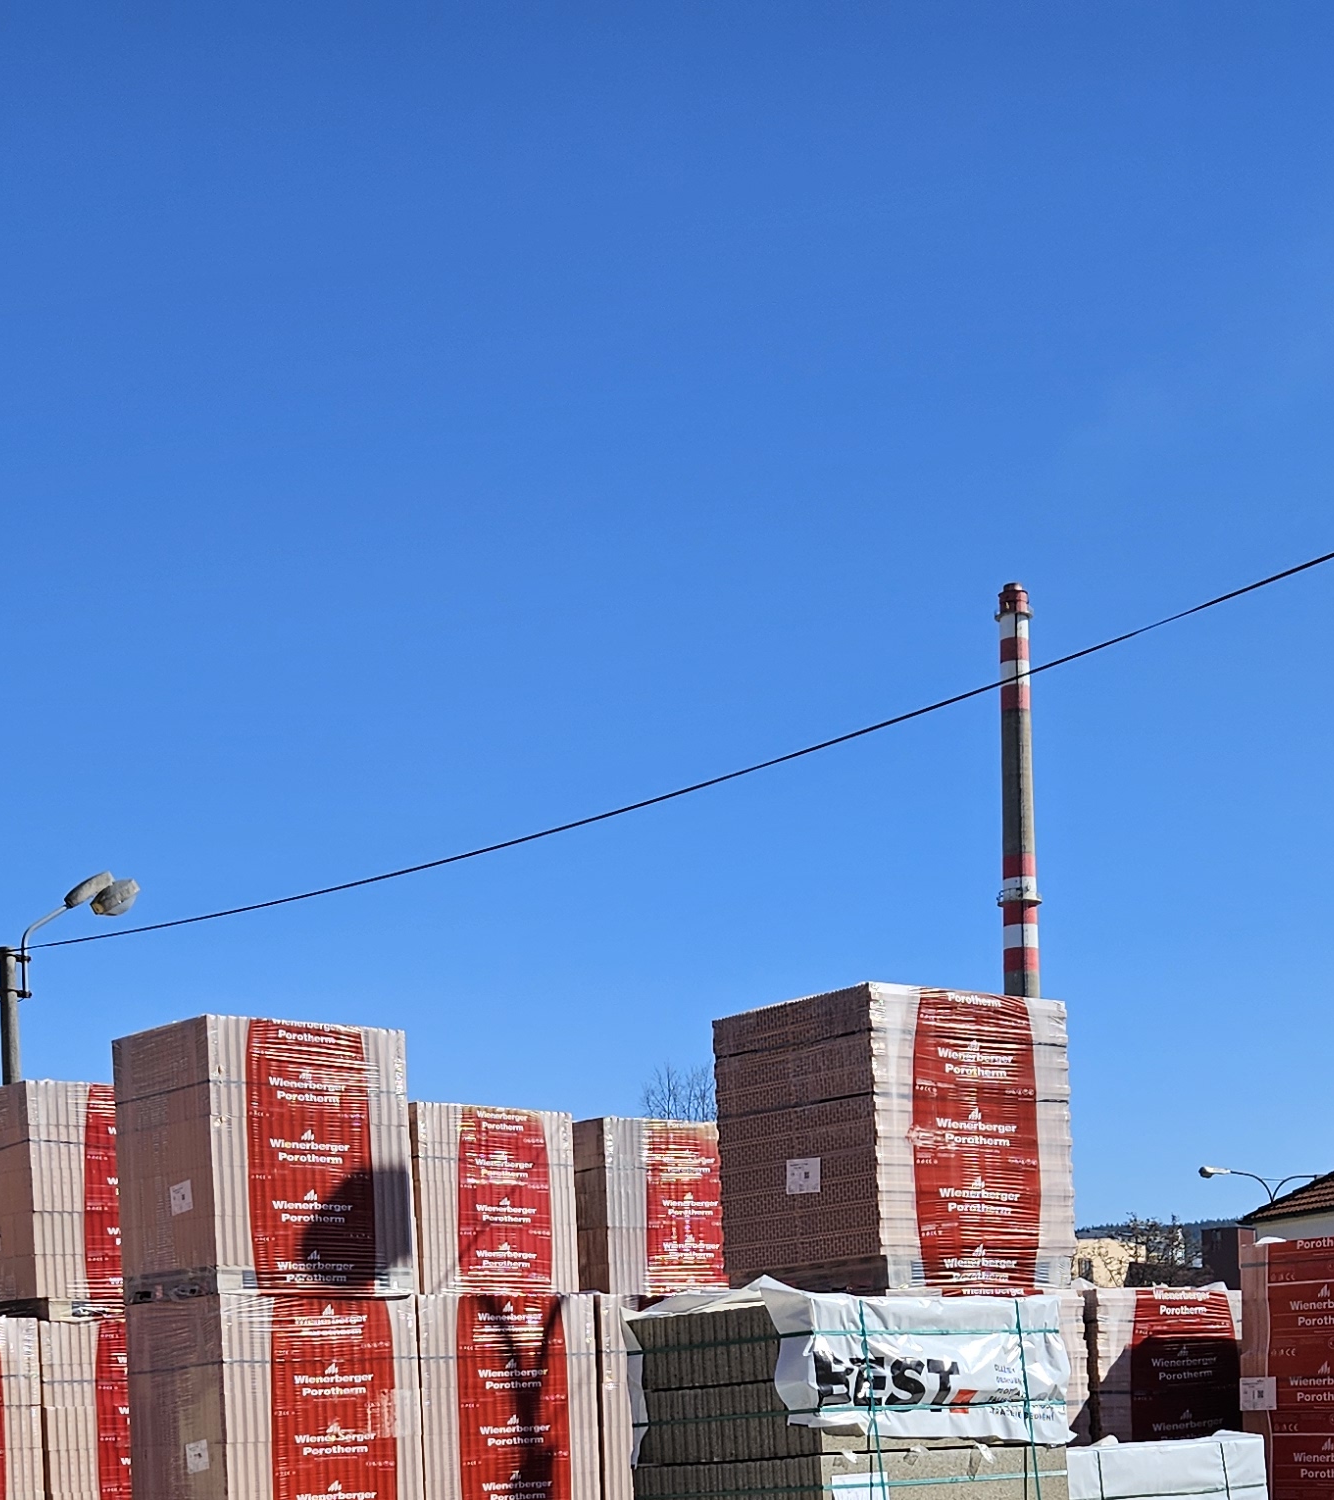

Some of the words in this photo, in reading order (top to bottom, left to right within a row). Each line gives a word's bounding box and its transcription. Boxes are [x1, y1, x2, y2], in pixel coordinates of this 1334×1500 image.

[948, 992, 1001, 1007] Porotherm
[278, 1030, 336, 1043] Porotherm
[938, 1047, 1013, 1063] Wienerberger
[945, 1064, 1007, 1077] Porotherm
[269, 1077, 346, 1091] Wienerberger
[277, 1091, 340, 1106] Porotherm
[477, 1110, 528, 1121] Wienerberger
[482, 1122, 524, 1131] Porotherm
[936, 1118, 1017, 1133] Wienerberger
[945, 1134, 1010, 1146] Porotherm
[270, 1139, 350, 1153] Wienerberger
[278, 1152, 343, 1164] Porotherm
[475, 1158, 533, 1169] Wienerberger
[939, 1188, 1020, 1201] Wienerberger
[272, 1200, 353, 1212] Wienerberger
[476, 1204, 537, 1215] Wienerberger
[948, 1203, 1012, 1215] Porotherm
[281, 1214, 345, 1223] Porotherm
[483, 1214, 531, 1223] Porotherm
[476, 1251, 537, 1259] Wienerberger
[277, 1262, 354, 1271] Wienerberger
[944, 1259, 1017, 1268] Wienerberger
[286, 1274, 347, 1282] Porotherm
[1154, 1291, 1210, 1301] Wienerberger
[1160, 1306, 1207, 1315] Porotherm
[478, 1313, 543, 1322] Wienerberger
[1151, 1356, 1216, 1367] Wienerberger
[478, 1369, 548, 1378] Wienerberger
[1159, 1370, 1212, 1380] Porotherm
[294, 1374, 373, 1384] Wienerberger
[486, 1381, 542, 1390] Porotherm
[302, 1387, 366, 1396] Porotherm
[1152, 1418, 1223, 1431] Wienerberger
[480, 1425, 550, 1435] Wienerberger
[488, 1437, 544, 1446] Porotherm
[303, 1445, 368, 1455] Porotherm
[482, 1481, 552, 1491] Wienerberger
